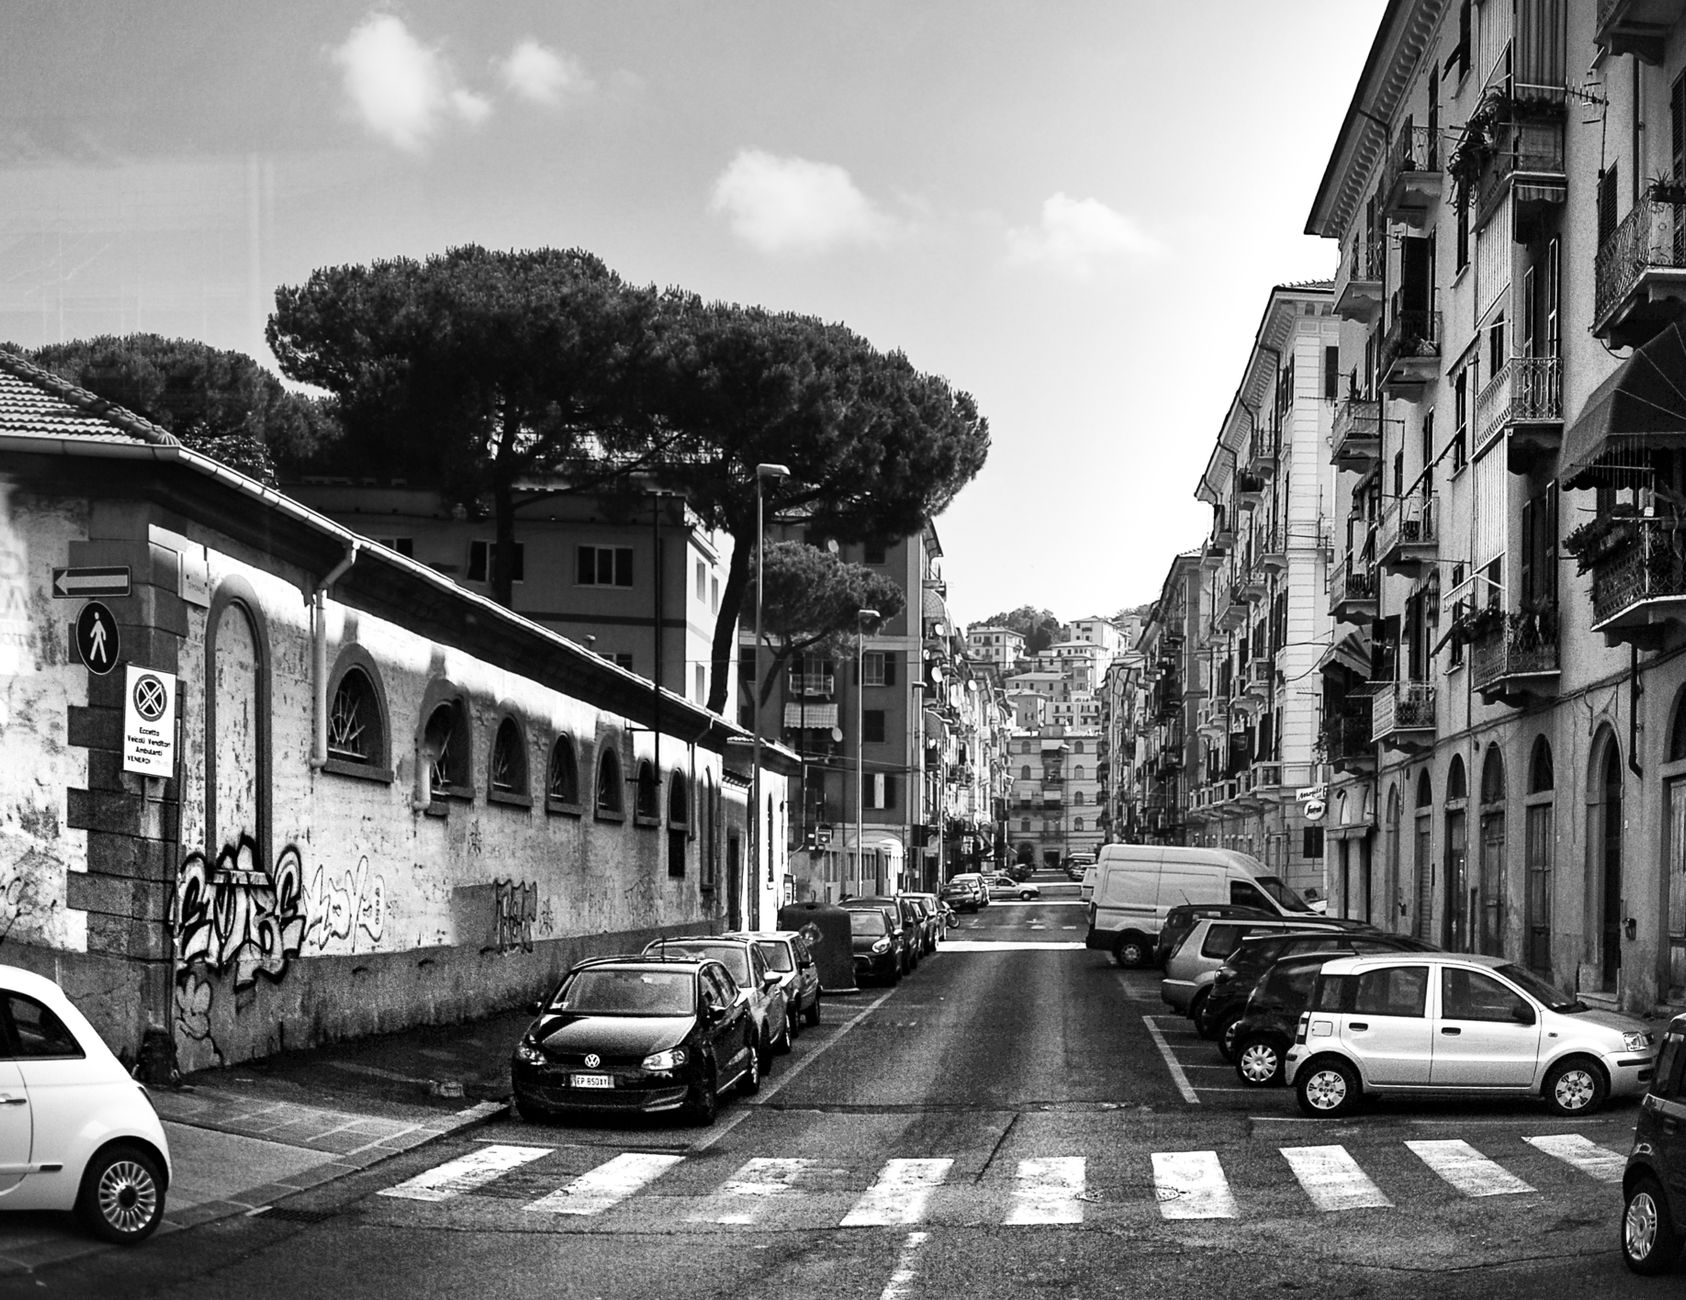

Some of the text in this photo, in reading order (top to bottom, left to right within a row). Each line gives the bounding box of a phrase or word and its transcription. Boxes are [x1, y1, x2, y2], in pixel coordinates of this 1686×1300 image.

[139, 726, 160, 737] Eccetto
[127, 735, 146, 744] Veicoli
[135, 746, 163, 756] Ambulanti
